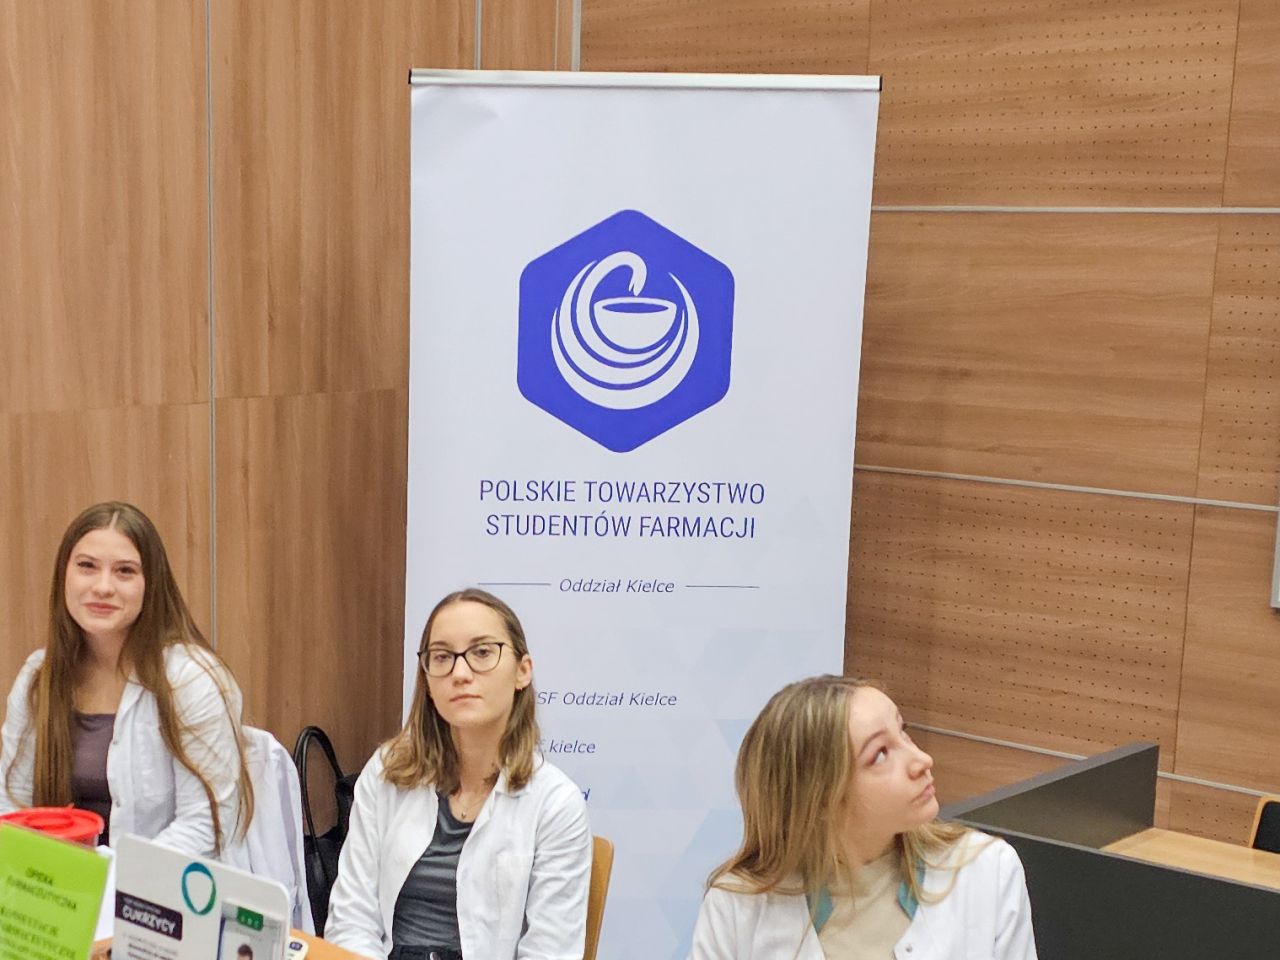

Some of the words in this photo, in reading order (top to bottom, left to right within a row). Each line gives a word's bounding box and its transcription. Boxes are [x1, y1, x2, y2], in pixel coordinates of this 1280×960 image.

[479, 480, 577, 503] POLSKIE
[584, 481, 765, 505] TOWARZYSTWO
[486, 511, 631, 537] STUDENTÓW
[639, 516, 755, 538] FARMACJI
[559, 578, 621, 593] Oddział
[626, 579, 675, 594] Kielce
[536, 691, 558, 705] SF
[563, 692, 624, 706] Oddział
[629, 692, 677, 706] Kielce
